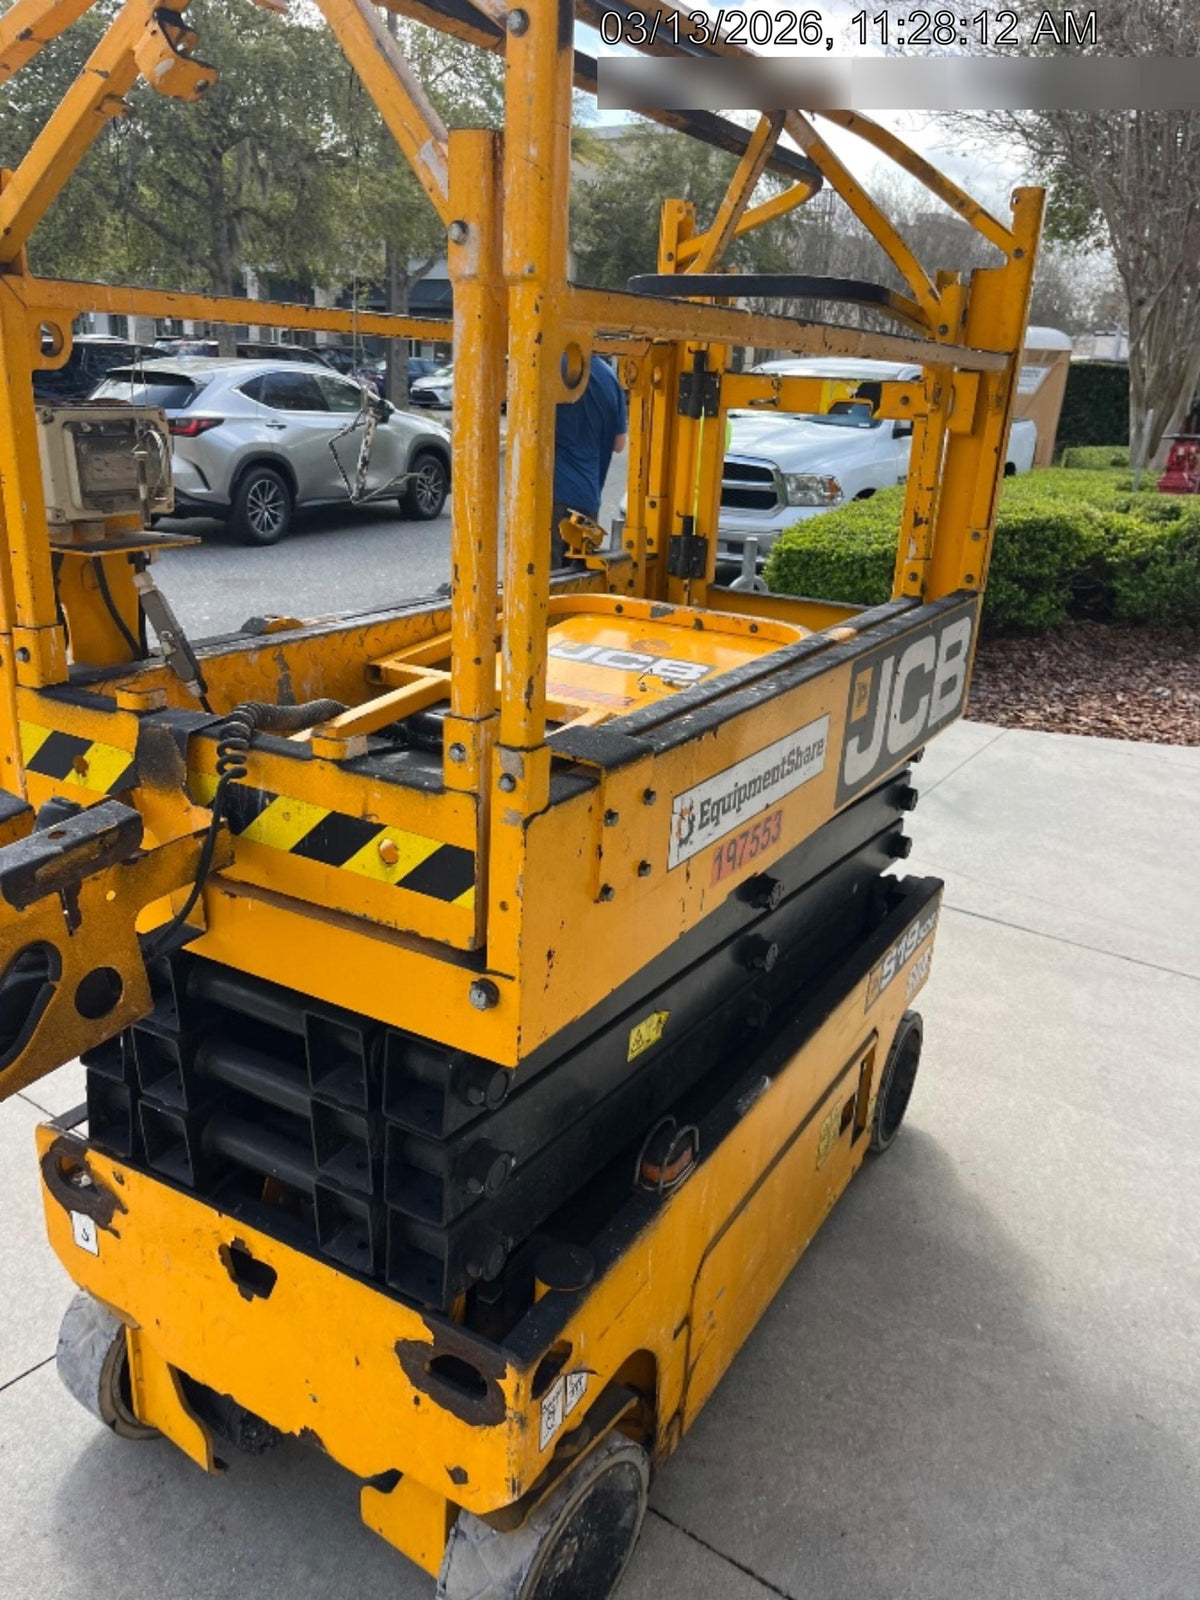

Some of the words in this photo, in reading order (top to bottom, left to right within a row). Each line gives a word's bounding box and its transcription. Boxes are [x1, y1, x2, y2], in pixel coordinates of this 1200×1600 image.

[549, 645, 709, 680] JCB
[844, 616, 972, 786] JCB
[698, 738, 824, 831] EquipmentShare
[714, 809, 783, 881] 197553
